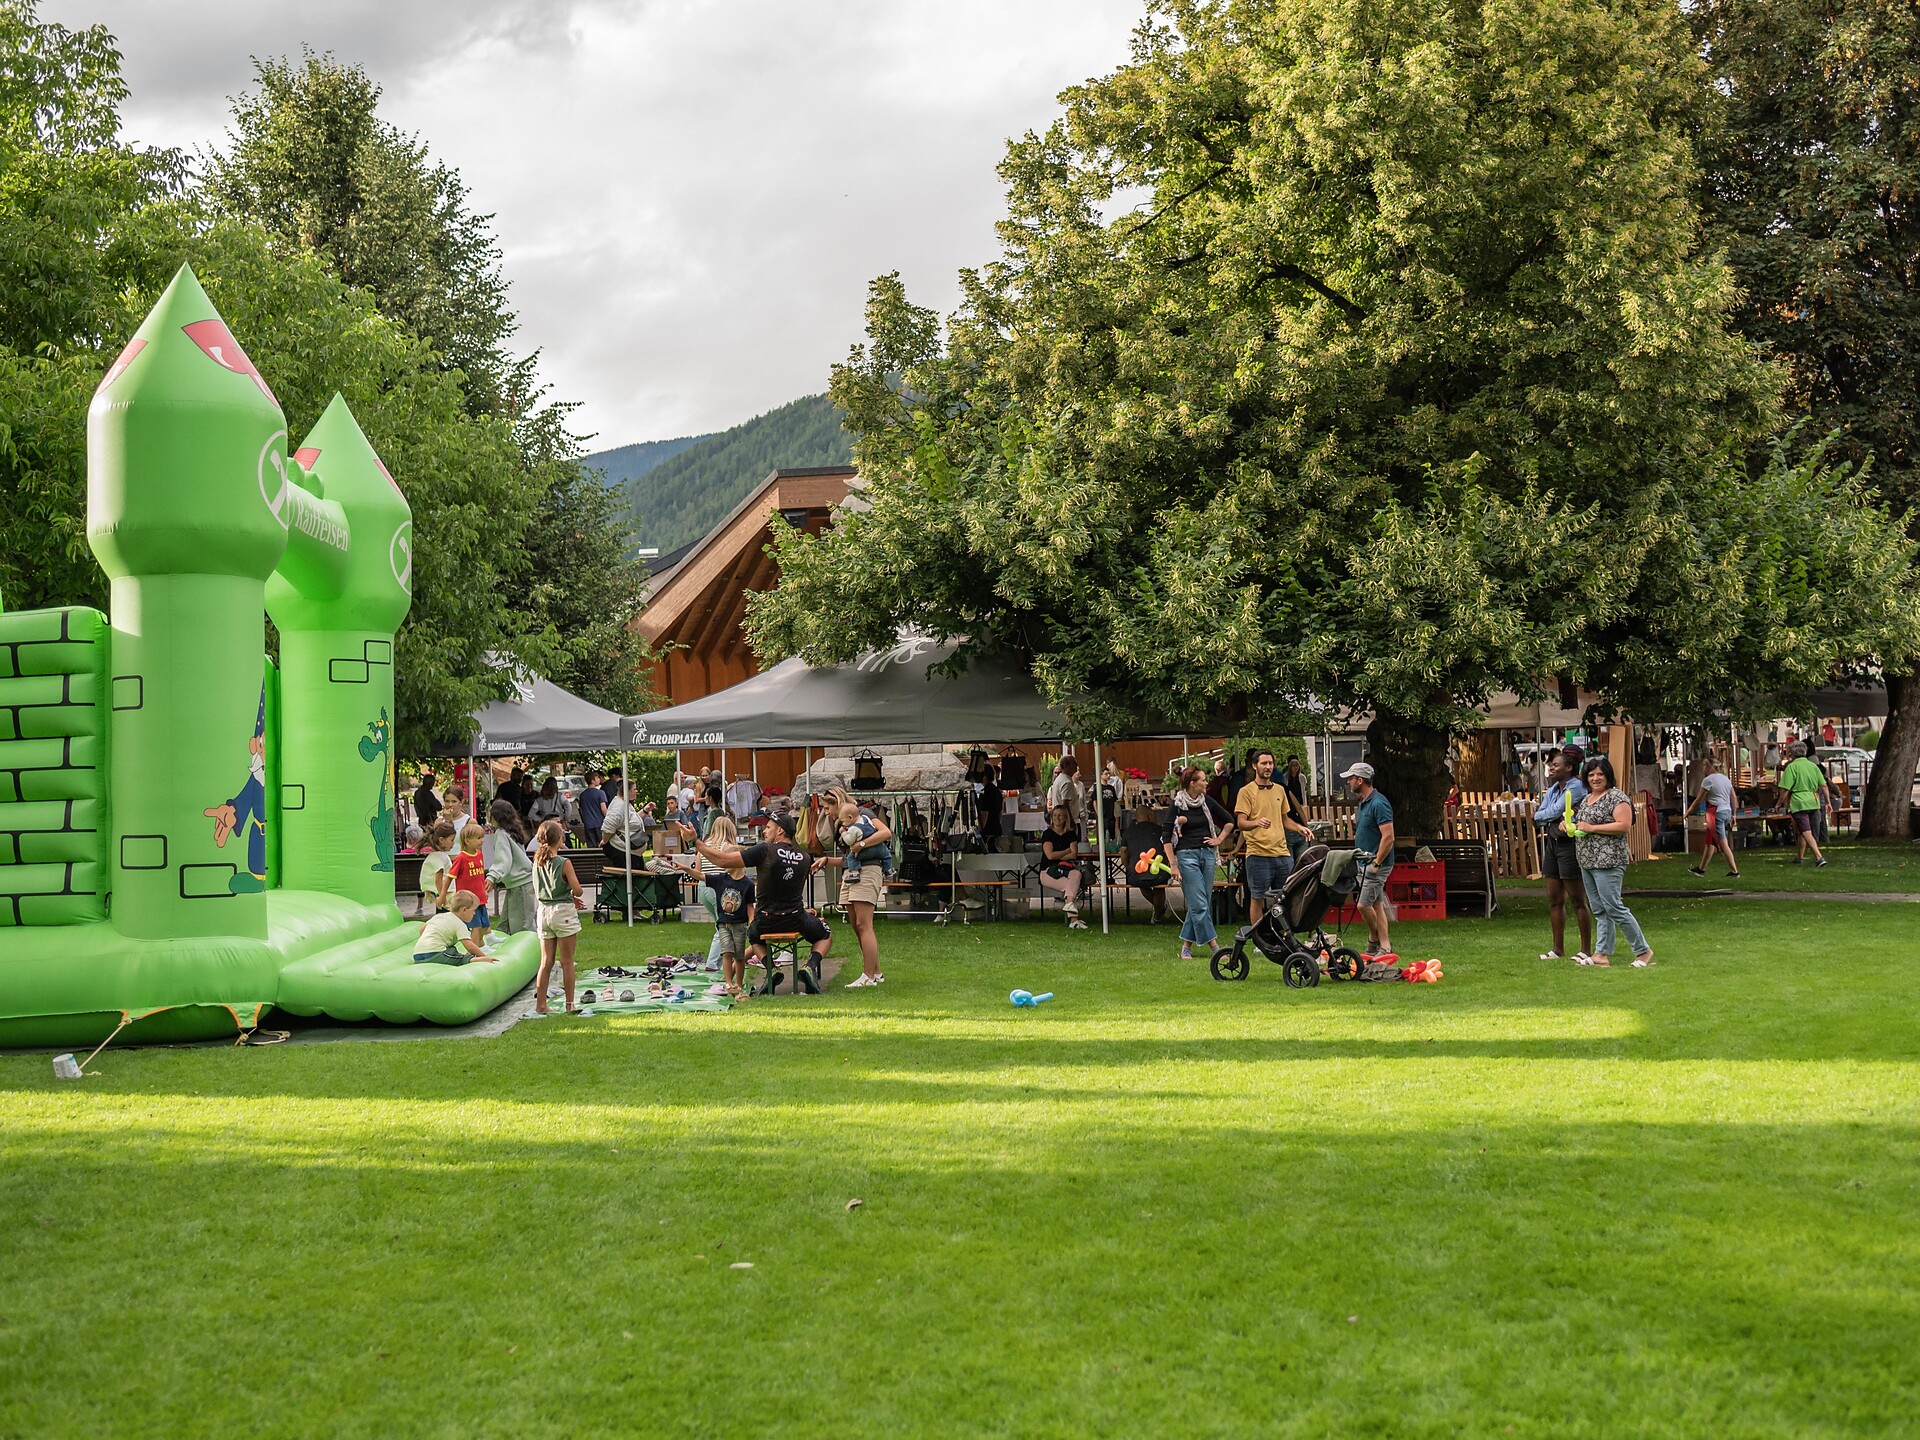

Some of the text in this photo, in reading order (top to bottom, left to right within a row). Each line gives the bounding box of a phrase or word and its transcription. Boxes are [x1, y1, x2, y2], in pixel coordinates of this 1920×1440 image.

[295, 496, 348, 551] Raiffeisen
[649, 732, 724, 744] KRONPLATZ.COM
[487, 742, 527, 751] KRONPLATZ.COM
